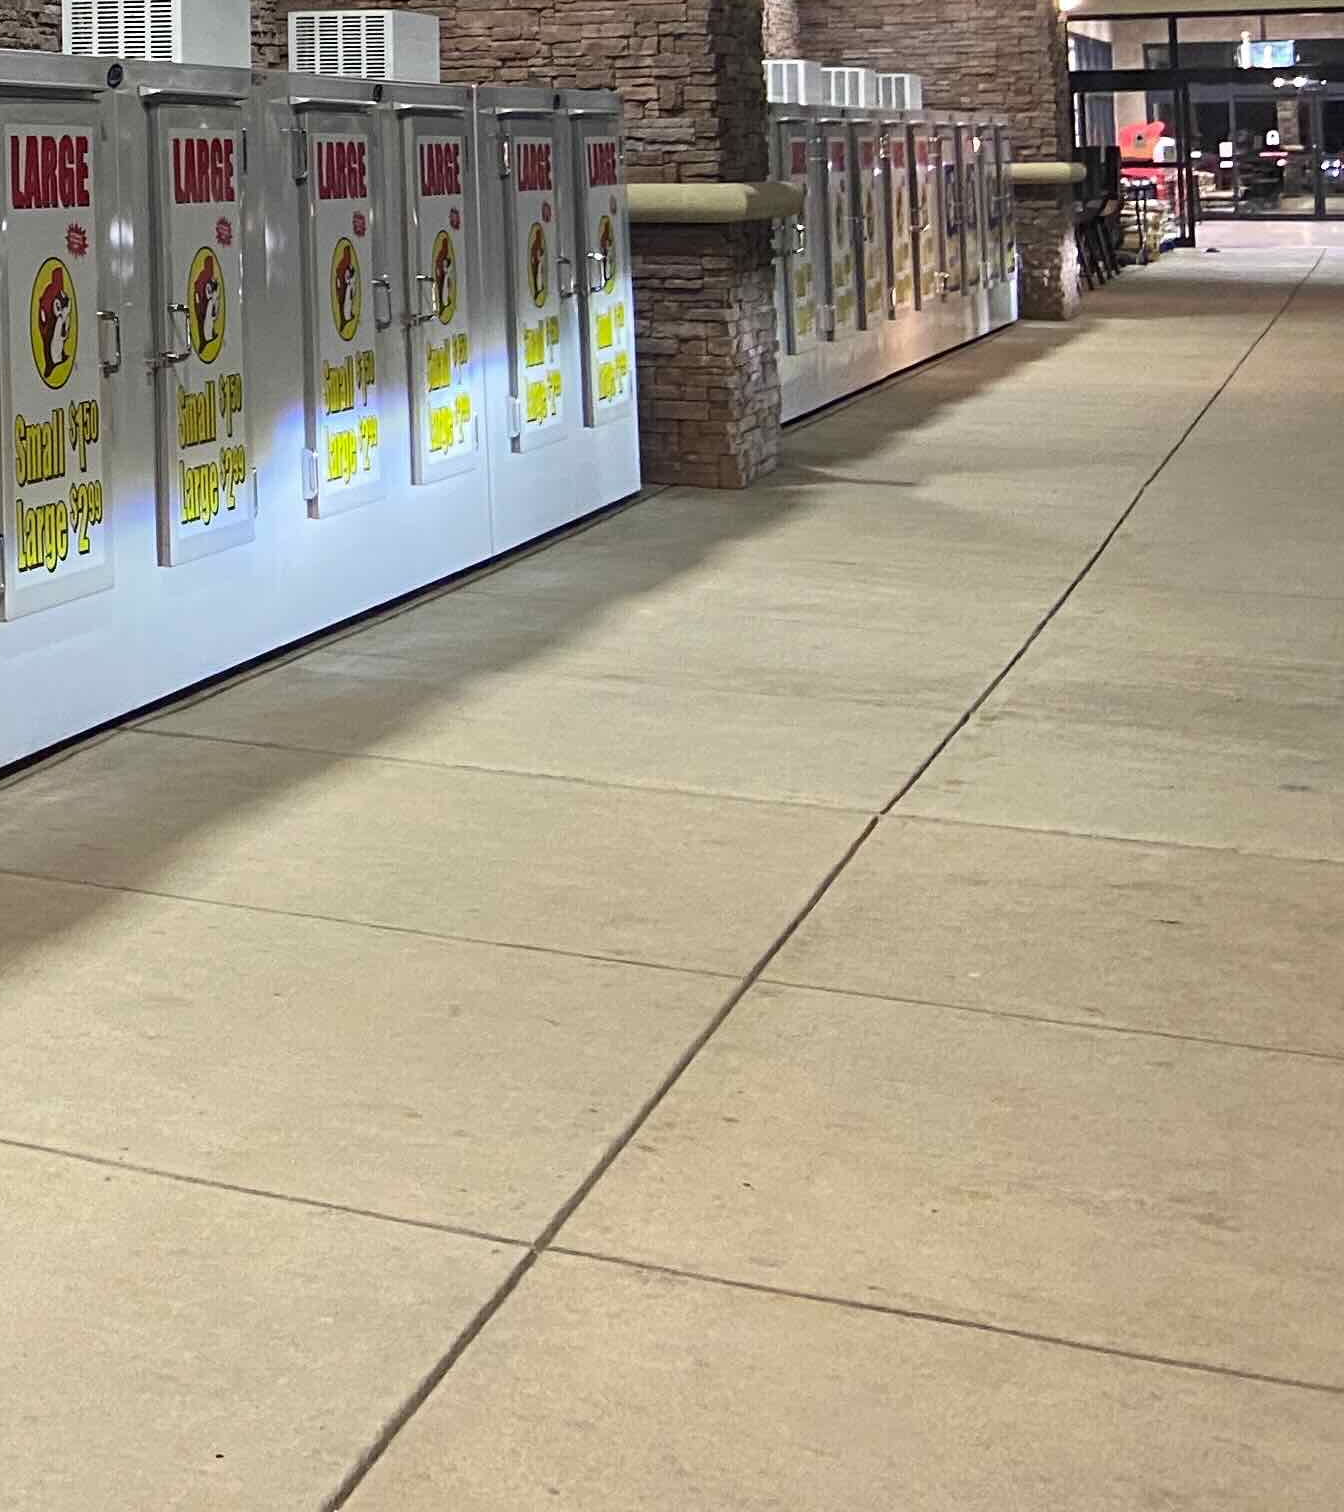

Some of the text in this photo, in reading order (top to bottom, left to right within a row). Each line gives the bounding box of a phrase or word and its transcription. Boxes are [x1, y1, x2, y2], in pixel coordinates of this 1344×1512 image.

[10, 135, 90, 209] LARGE
[173, 138, 235, 204] LARGE
[317, 141, 368, 200] LARGE
[420, 143, 462, 197] LARGE
[14, 407, 66, 487] Small
[179, 460, 219, 525] Large
[16, 498, 69, 573] Large
